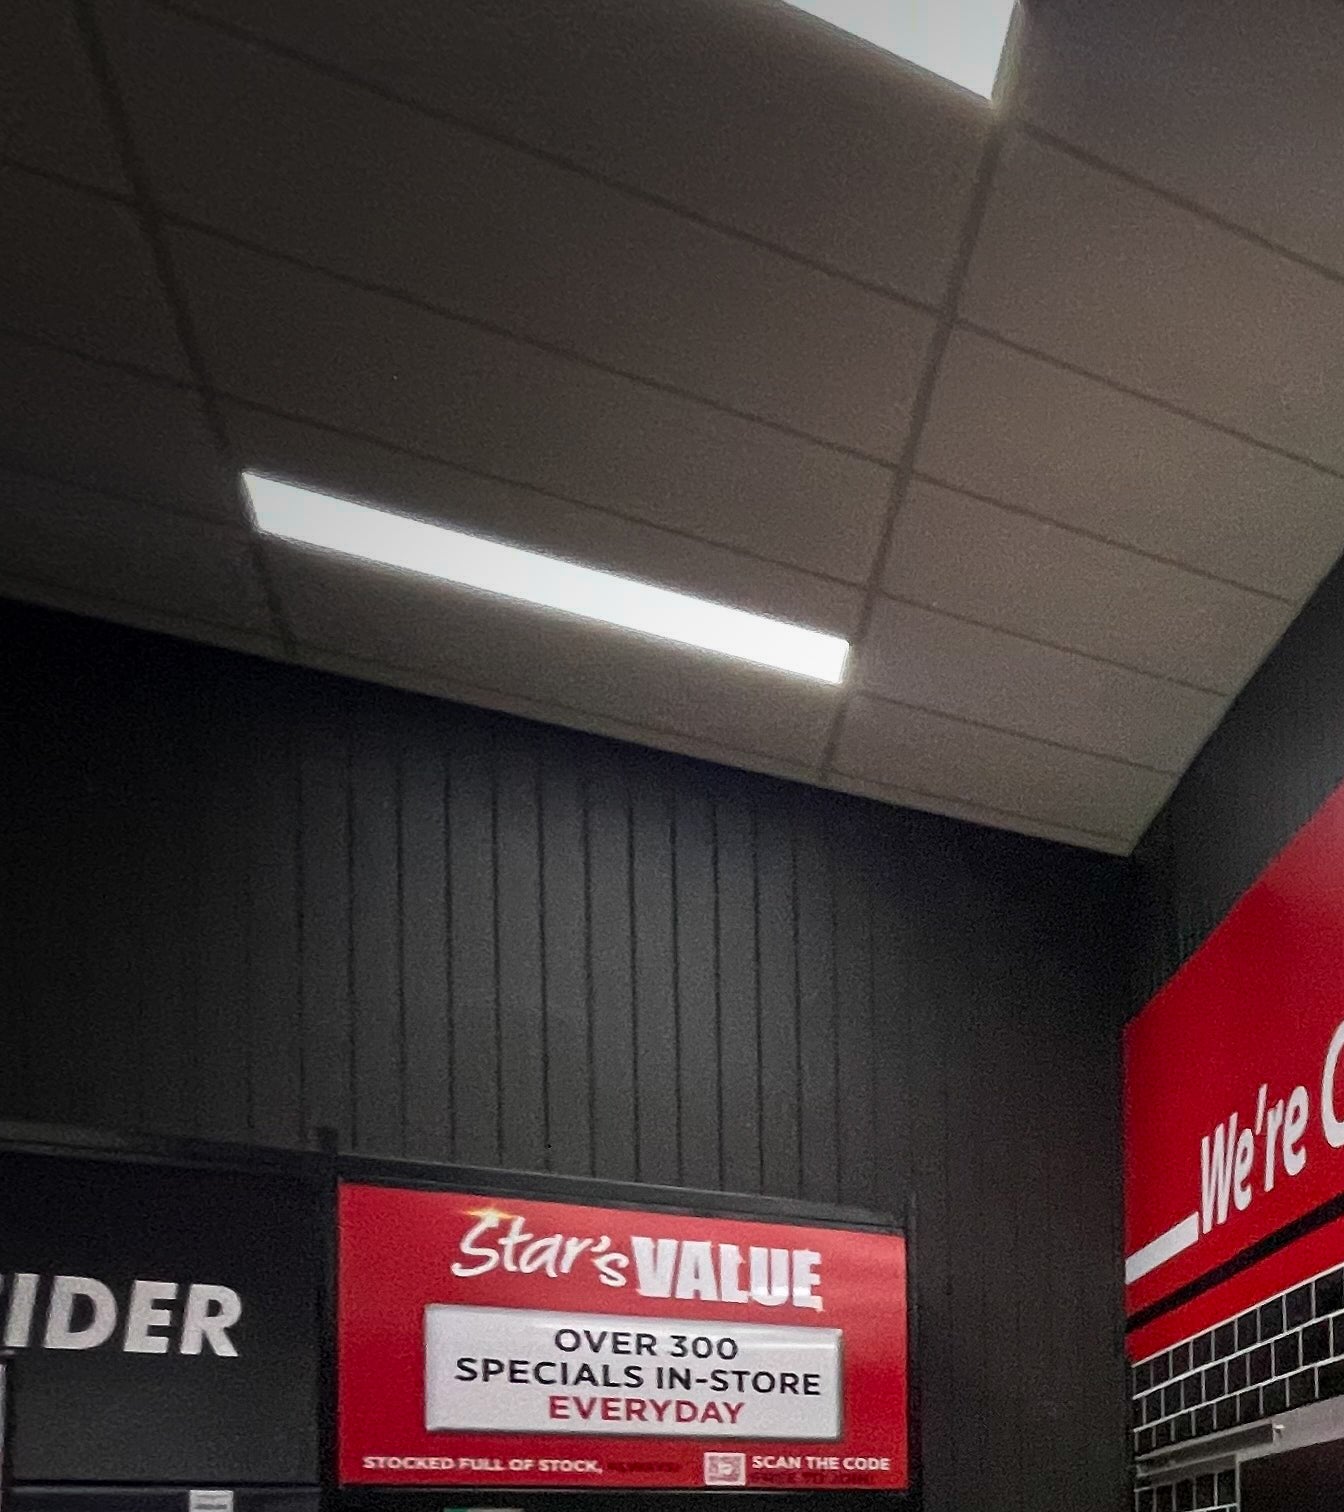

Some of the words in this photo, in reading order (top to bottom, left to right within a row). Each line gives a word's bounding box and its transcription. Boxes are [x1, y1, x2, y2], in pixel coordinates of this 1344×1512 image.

[1200, 1084, 1309, 1235] We're
[451, 1209, 627, 1288] Star's
[632, 1236, 824, 1311] VALUE
[0, 1272, 242, 1357] IDER
[554, 1328, 657, 1357] OVER
[671, 1335, 738, 1361] 300
[455, 1357, 644, 1390] SPECIALS
[656, 1367, 821, 1396] IN-STORE
[549, 1395, 745, 1425] EVERYDAY
[363, 1456, 454, 1470] STOCKED
[460, 1458, 505, 1471] FULL
[509, 1459, 533, 1470] OF
[752, 1456, 801, 1469] SCAN
[806, 1457, 839, 1470] THE
[843, 1458, 890, 1471] CODE
